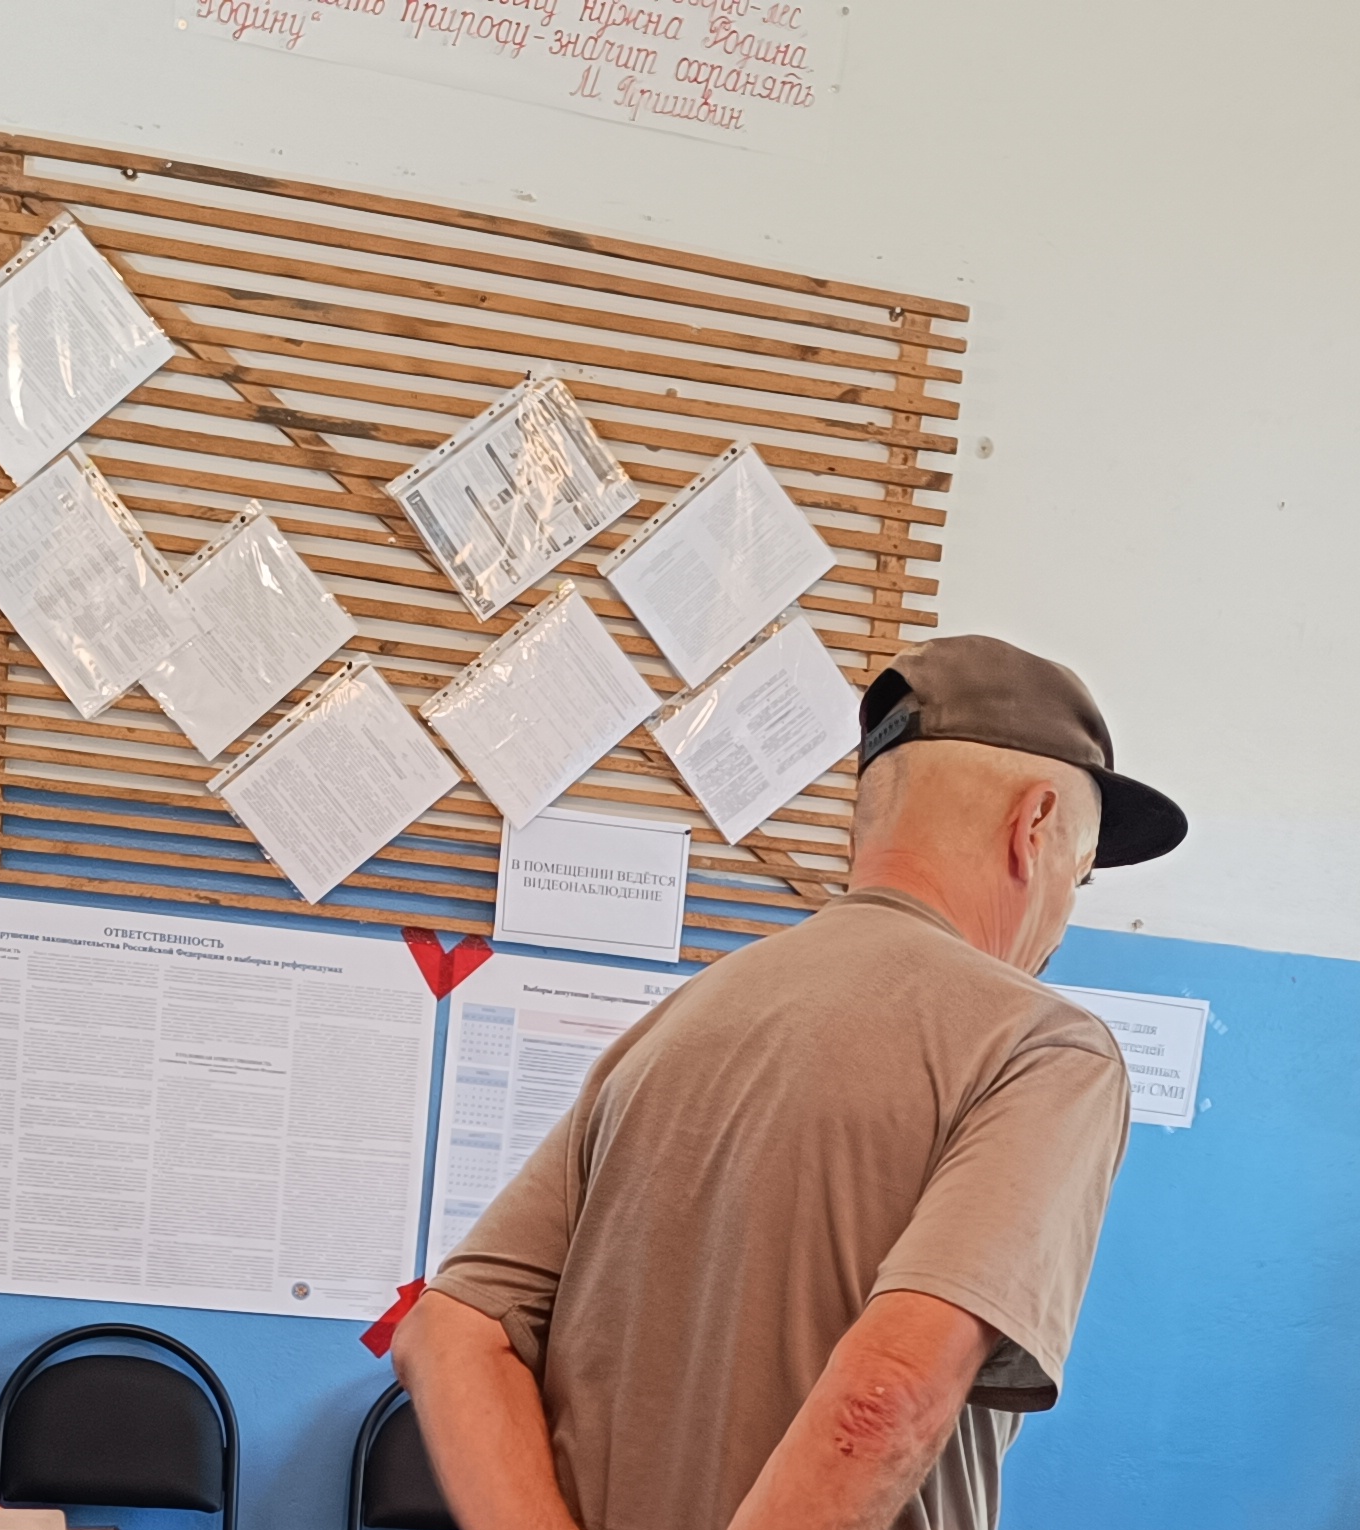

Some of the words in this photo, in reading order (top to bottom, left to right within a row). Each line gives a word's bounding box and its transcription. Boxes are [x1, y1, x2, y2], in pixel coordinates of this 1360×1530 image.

[675, 57, 815, 108] охранять
[511, 858, 520, 870] В
[524, 860, 613, 880] ПОМЕЩЕНИИ
[617, 871, 676, 887] ВЕДЁТСЯ
[523, 876, 662, 901] ВИДЕОНАБЛЮДЕНИЕ
[104, 926, 224, 949] ОТВЕТСТВЕННОСТЬ
[122, 942, 174, 955] Российской
[1150, 1083, 1186, 1100] СМИ
